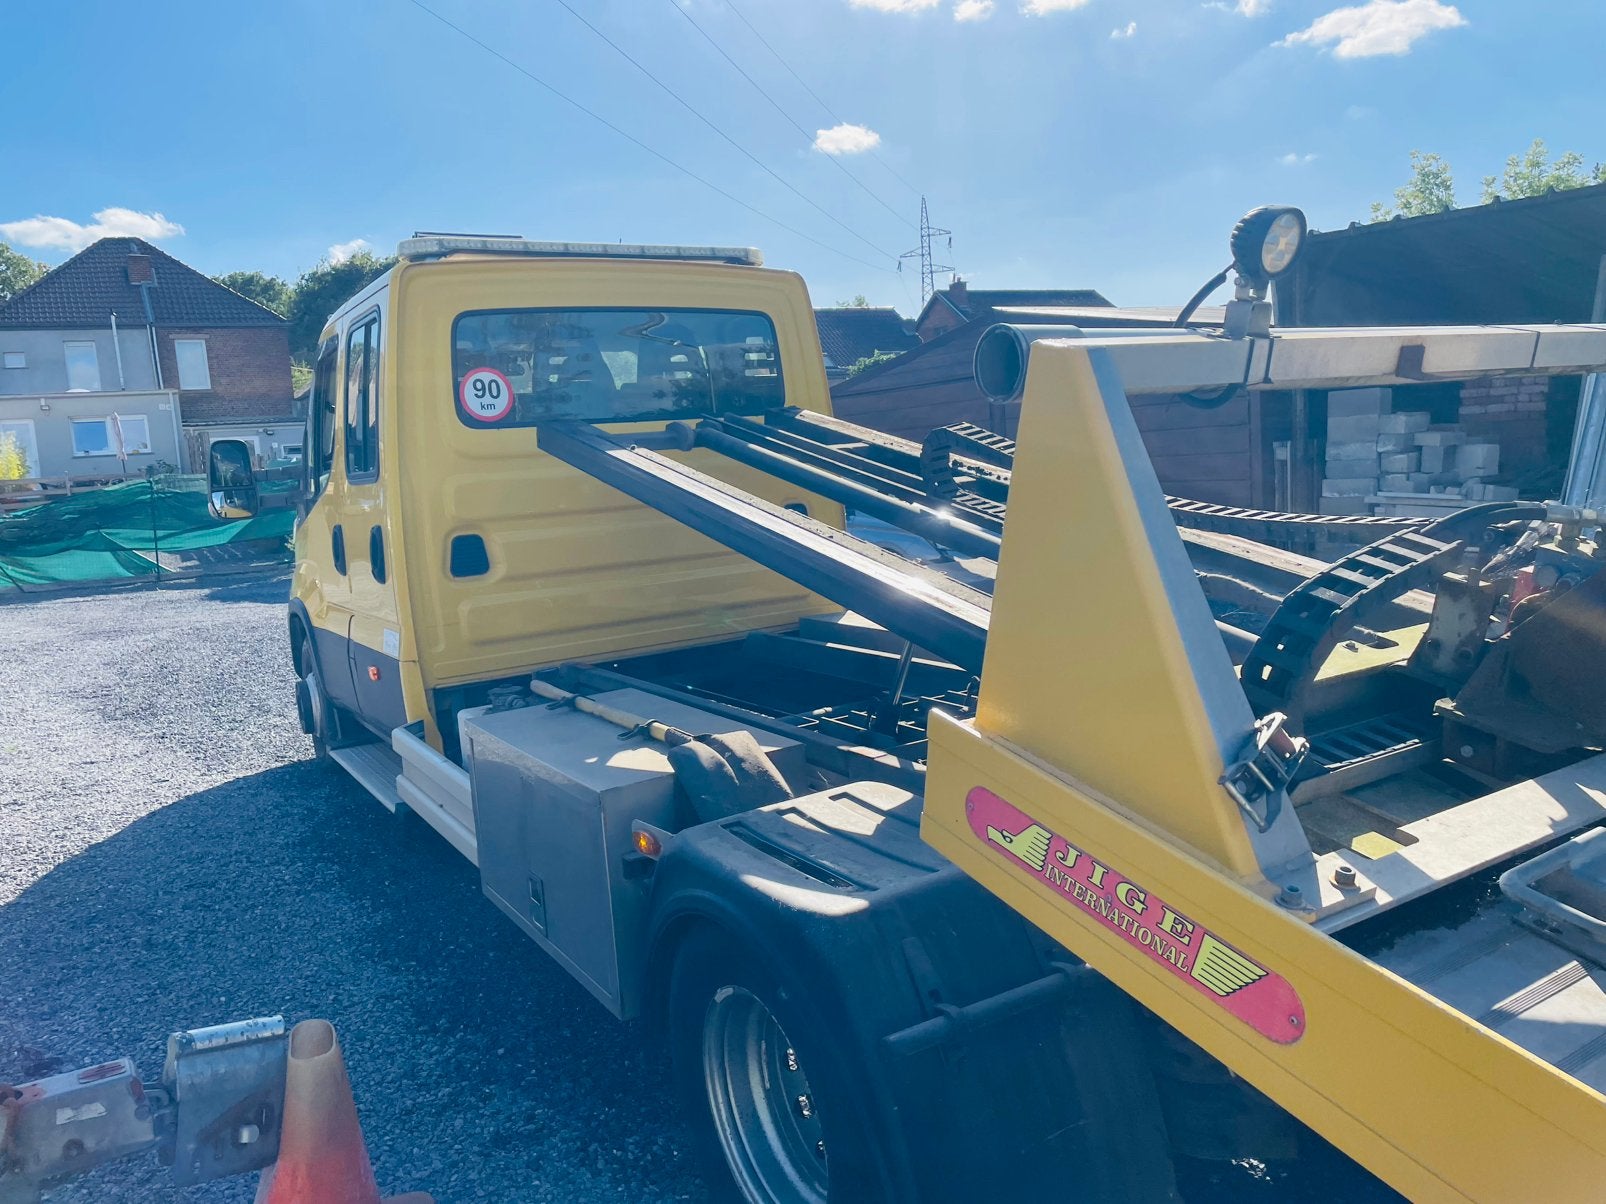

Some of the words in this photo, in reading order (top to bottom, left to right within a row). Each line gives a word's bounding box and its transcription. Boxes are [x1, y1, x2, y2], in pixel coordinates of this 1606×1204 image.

[472, 378, 501, 399] 90
[480, 402, 496, 411] km
[1044, 863, 1189, 973] INTERNATIONAL
[1055, 843, 1195, 946] JIGE
